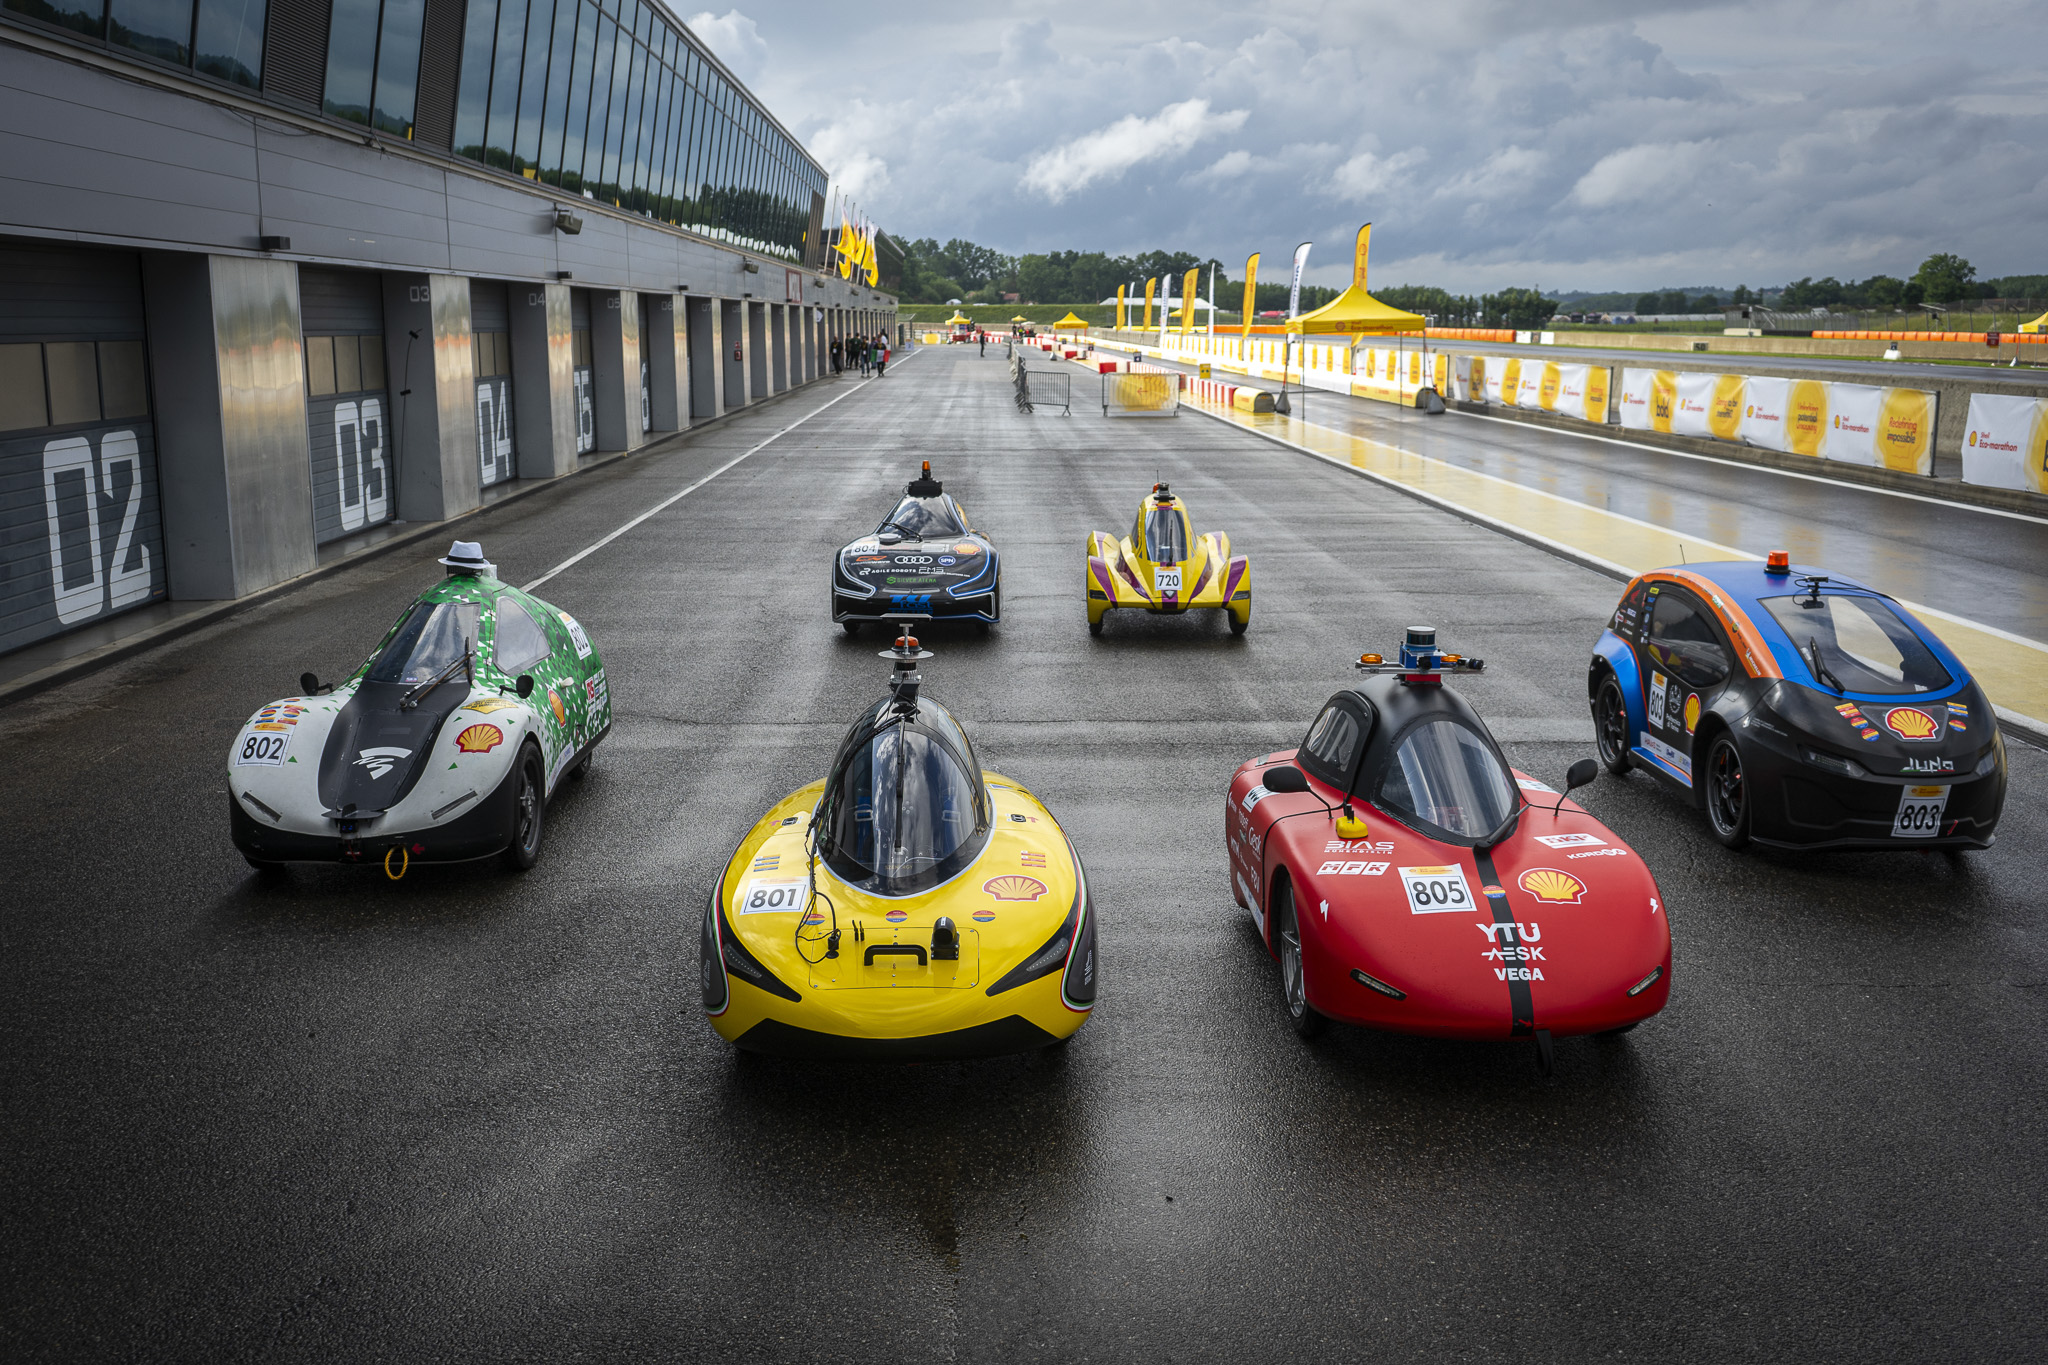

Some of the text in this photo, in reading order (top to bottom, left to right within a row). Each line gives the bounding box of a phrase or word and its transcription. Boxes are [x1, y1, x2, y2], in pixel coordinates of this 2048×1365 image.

[410, 286, 429, 302] 03
[529, 293, 545, 306] 04
[1656, 396, 1670, 419] bold
[477, 381, 511, 485] 04
[1888, 416, 1918, 433] Redefining
[1887, 429, 1916, 444] impossible
[1979, 440, 2018, 452] Eco-marathon
[334, 399, 386, 531] 03
[43, 430, 151, 625] 02
[1158, 575, 1179, 586] 720
[1651, 690, 1664, 721] 803
[243, 737, 284, 760] 802
[1900, 804, 1940, 830] 803
[1324, 840, 1395, 850] BIAS
[749, 888, 797, 909] 801
[1412, 881, 1466, 906] 805
[1475, 922, 1541, 943] YTU
[1494, 967, 1545, 981] VEGA
